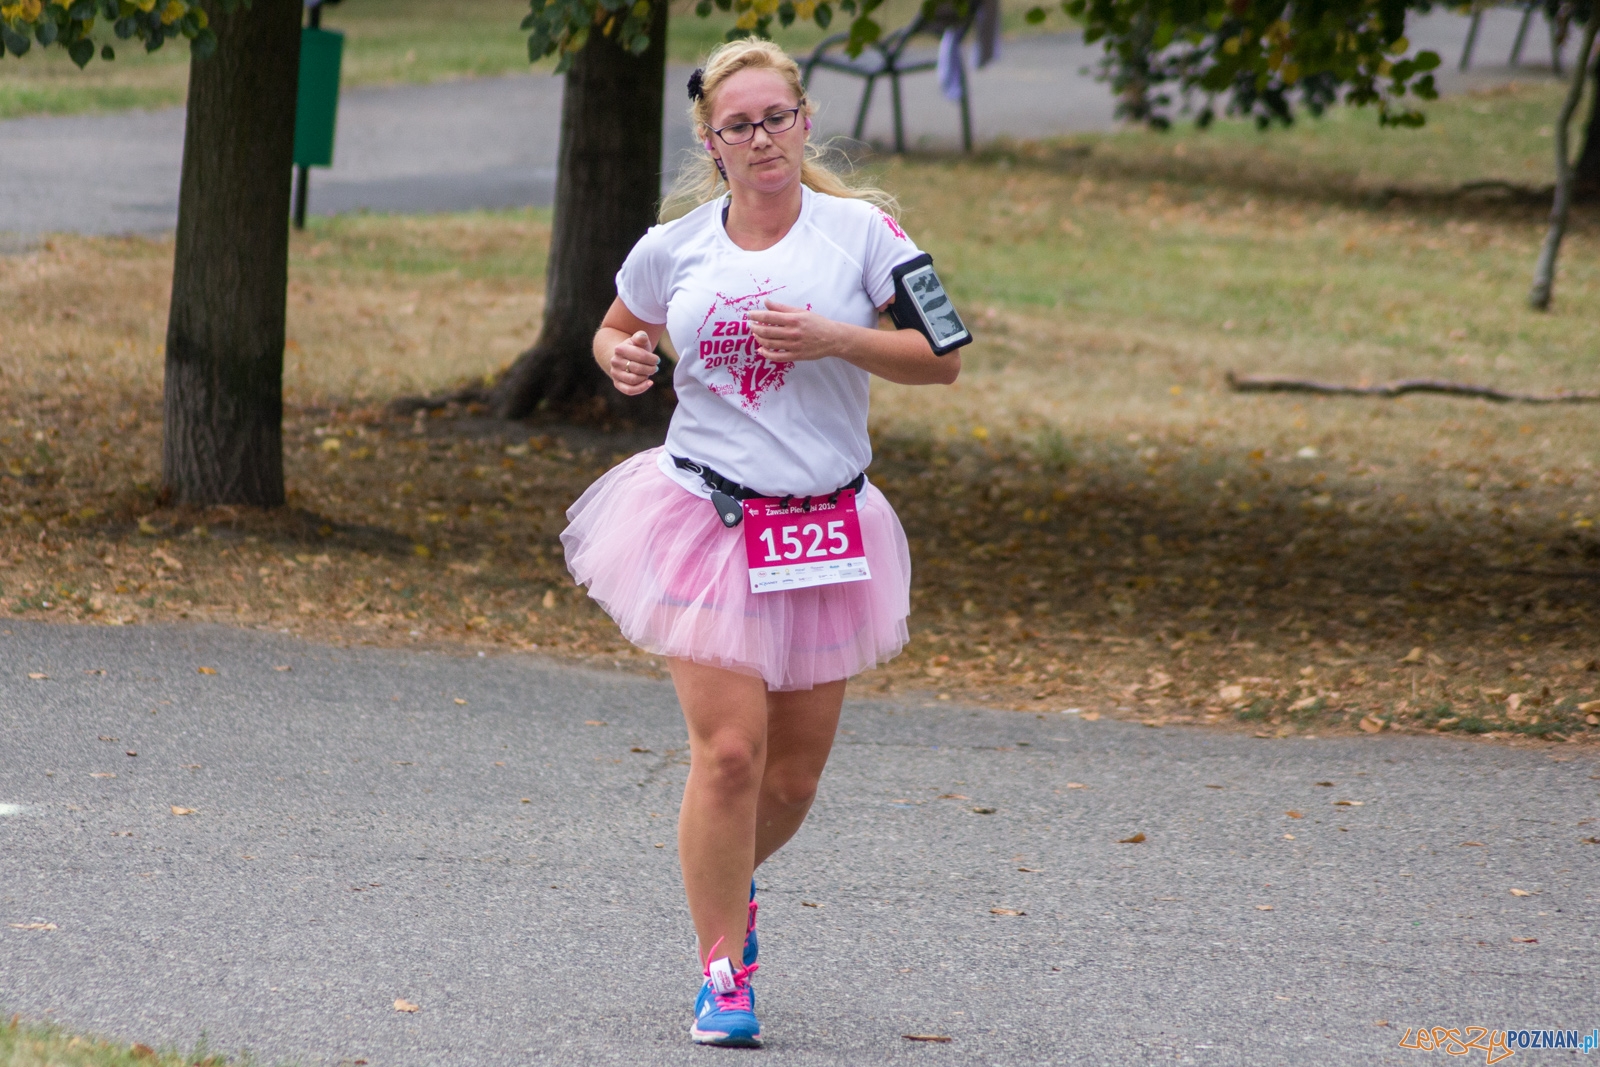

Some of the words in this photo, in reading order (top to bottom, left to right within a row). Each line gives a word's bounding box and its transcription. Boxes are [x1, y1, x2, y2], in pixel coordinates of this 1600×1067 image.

[704, 354, 738, 369] 2016
[765, 508, 789, 516] Zawsze
[818, 503, 836, 511] 2016
[759, 520, 849, 562] 1525
